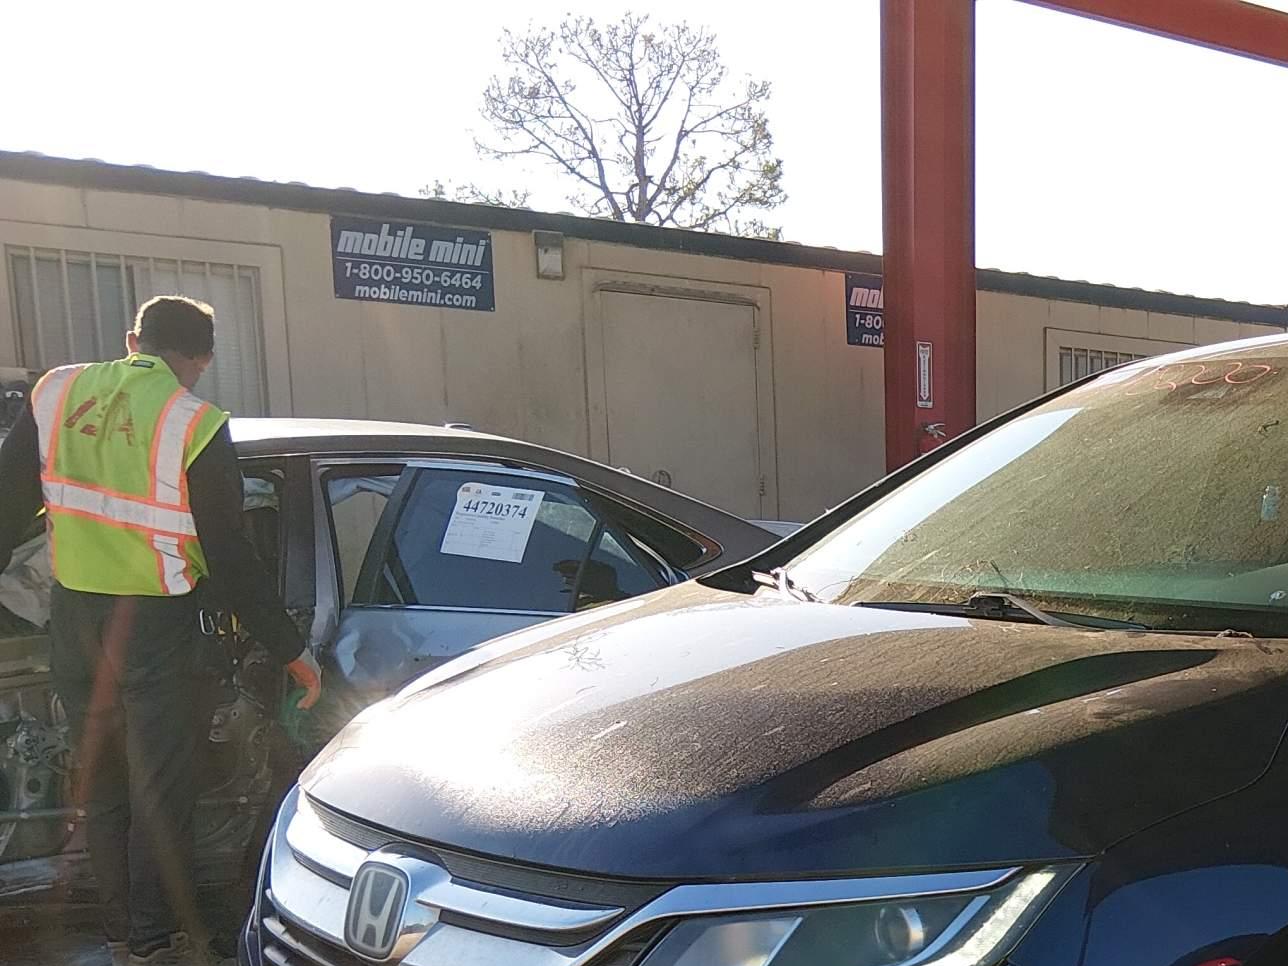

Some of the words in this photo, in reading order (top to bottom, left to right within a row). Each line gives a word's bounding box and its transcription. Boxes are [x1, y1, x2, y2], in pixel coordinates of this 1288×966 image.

[337, 223, 425, 261] mobile
[428, 236, 486, 267] mini
[345, 262, 482, 290] 1-800-950-6464
[354, 284, 477, 308] mobilemini.com
[855, 313, 884, 330] 1-80
[463, 498, 529, 519] 44720374
